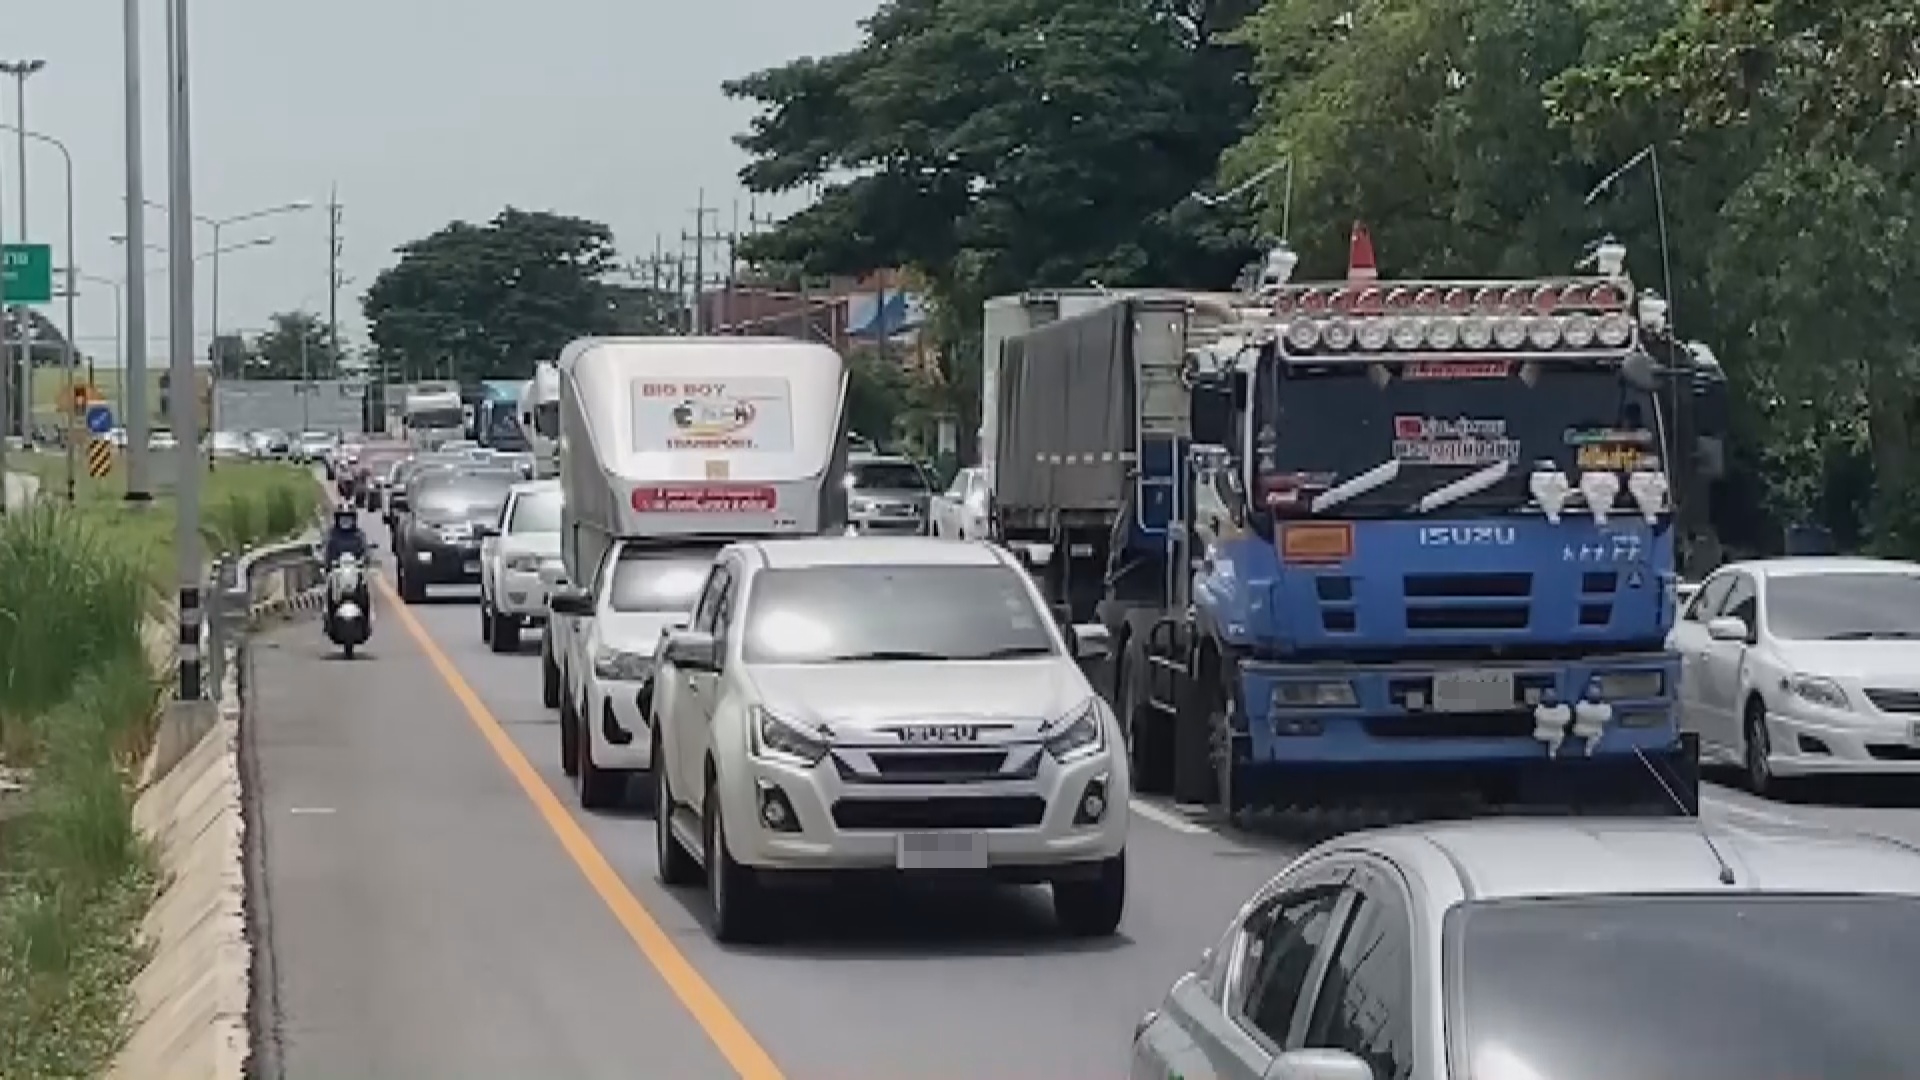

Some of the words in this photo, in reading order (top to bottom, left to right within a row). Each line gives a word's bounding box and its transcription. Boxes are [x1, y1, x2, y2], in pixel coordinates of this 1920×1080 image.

[642, 383, 677, 397] BIG
[683, 383, 727, 397] BOY
[1419, 527, 1515, 545] ISUZU
[902, 727, 974, 741] ISUZU
